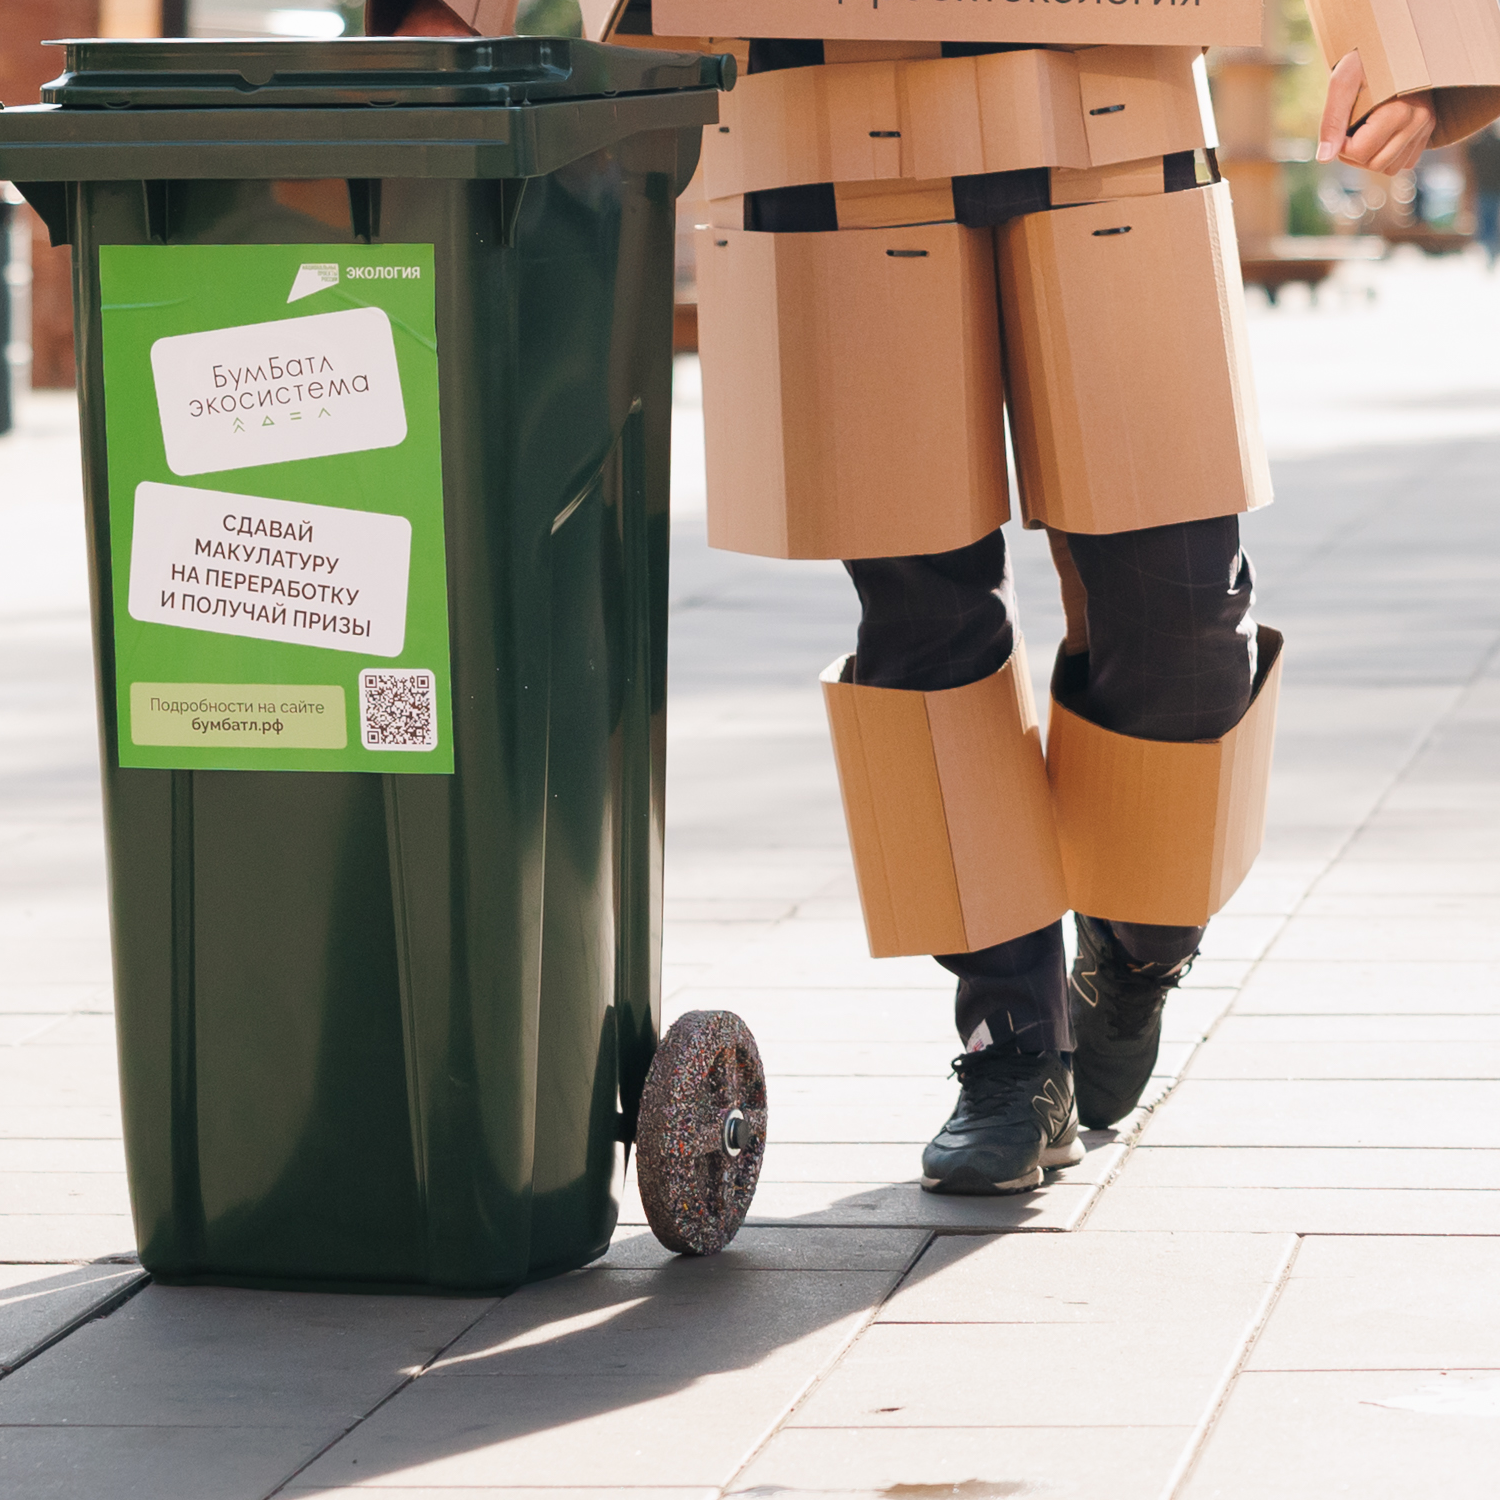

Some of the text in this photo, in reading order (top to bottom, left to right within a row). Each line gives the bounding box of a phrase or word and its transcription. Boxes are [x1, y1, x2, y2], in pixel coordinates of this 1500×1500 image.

[346, 266, 420, 279] ЭКОЛОГИЯ
[212, 356, 334, 391] БумБатл
[188, 374, 370, 417] экосистема
[223, 514, 313, 543] СДАВАЙ
[195, 538, 339, 574] МАКУЛАТУРУ
[171, 563, 360, 606] НА ПЕРЕРАБОТКУ
[160, 590, 372, 637] И ПОЛУЧАЙ ПРИЗЫ
[150, 698, 325, 715] Подробности на сайте
[191, 717, 284, 735] бумбатл.рф
